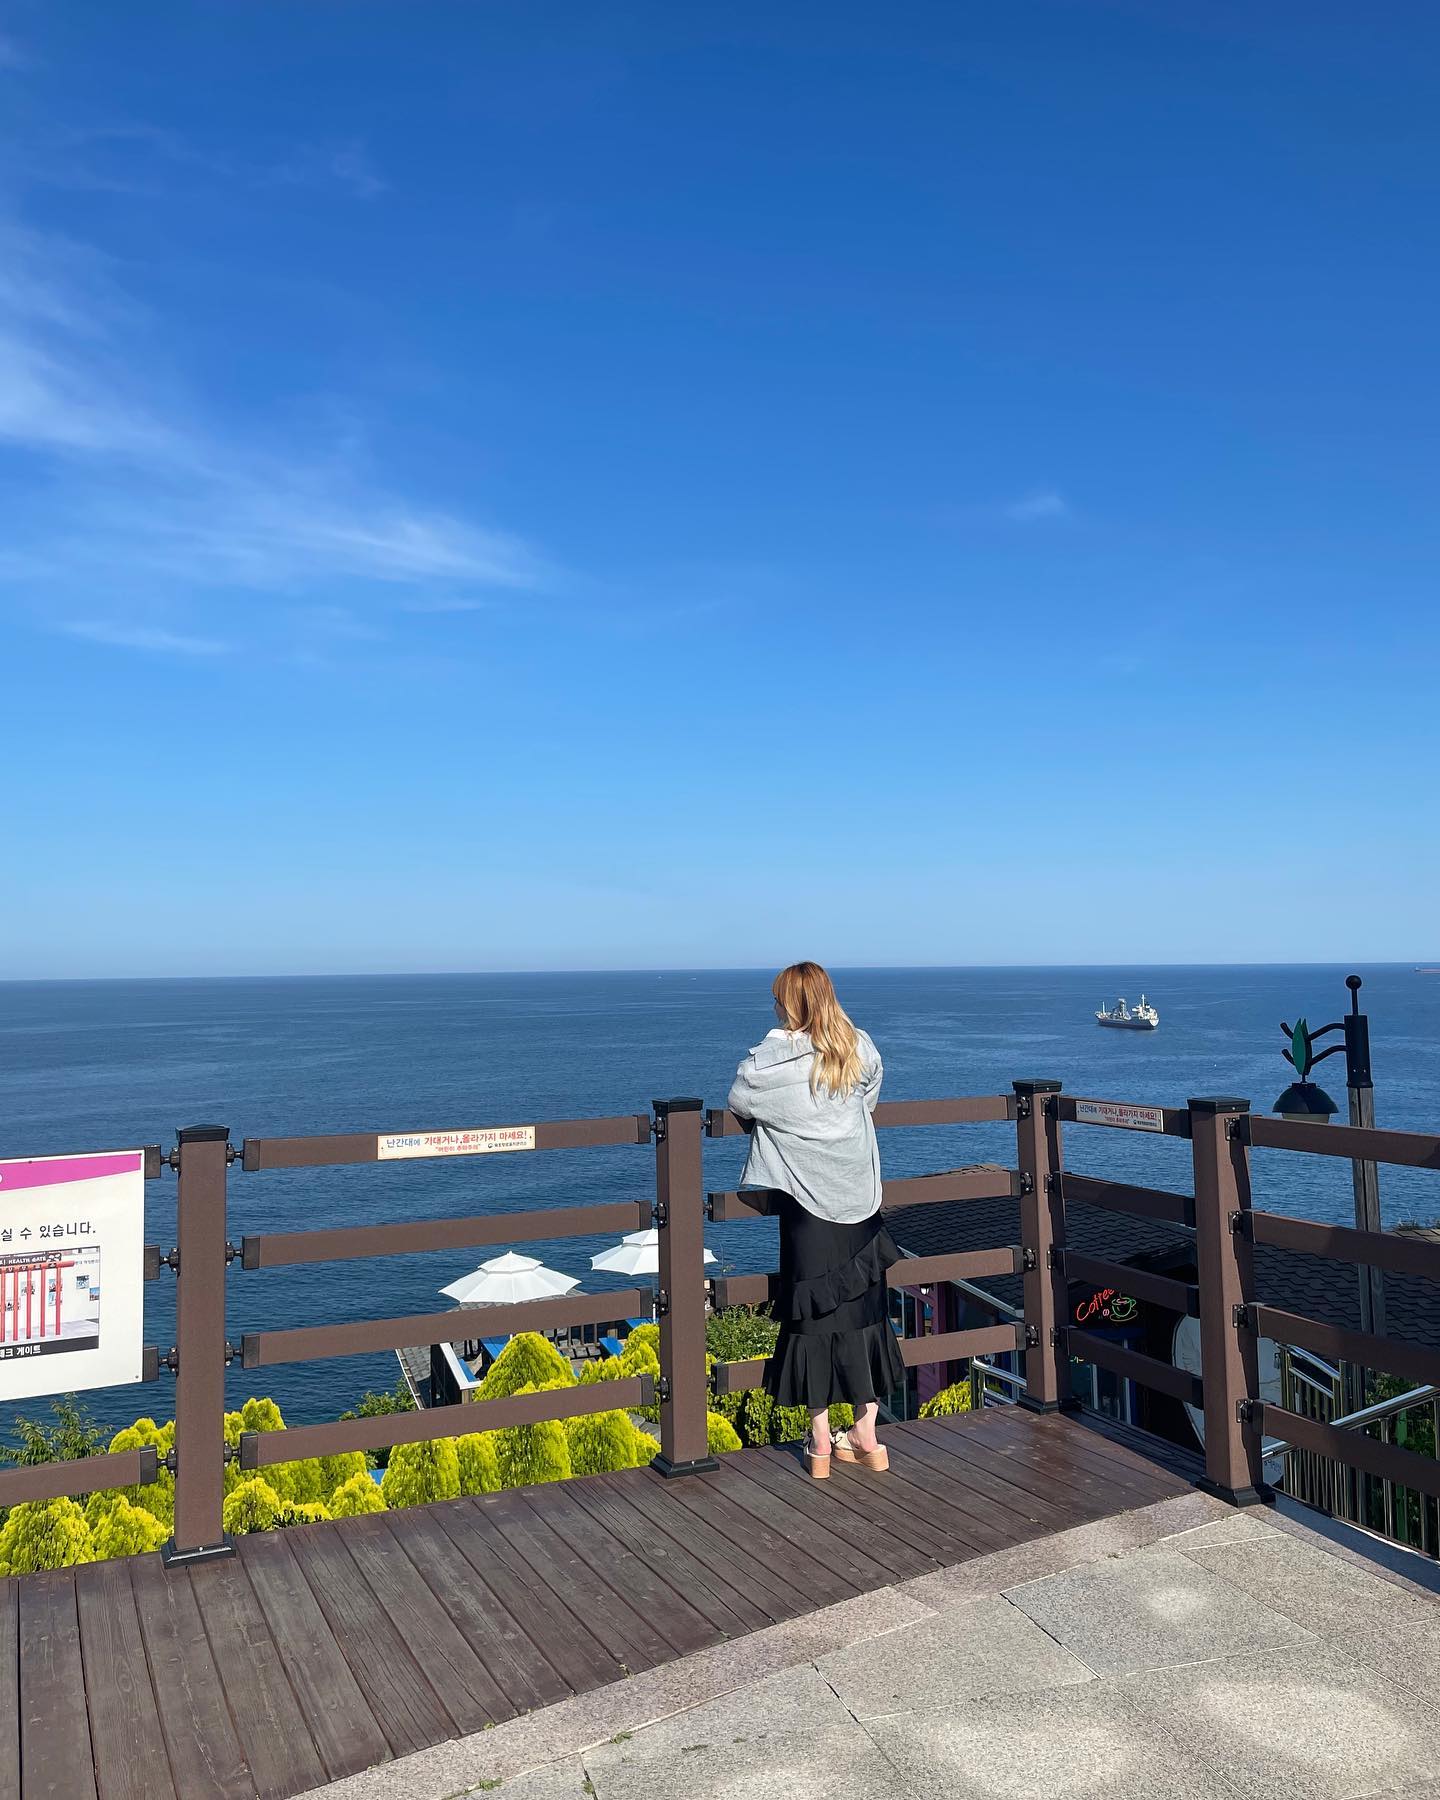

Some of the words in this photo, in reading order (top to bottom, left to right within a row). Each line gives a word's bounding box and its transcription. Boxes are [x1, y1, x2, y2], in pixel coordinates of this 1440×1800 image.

[386, 1138, 421, 1148] 난간대에
[499, 1130, 527, 1140] 마세요!
[1, 1228, 13, 1241] 실
[20, 1227, 32, 1240] 수
[39, 1221, 96, 1238] 있습니다.
[16, 1345, 41, 1356] 게이트
